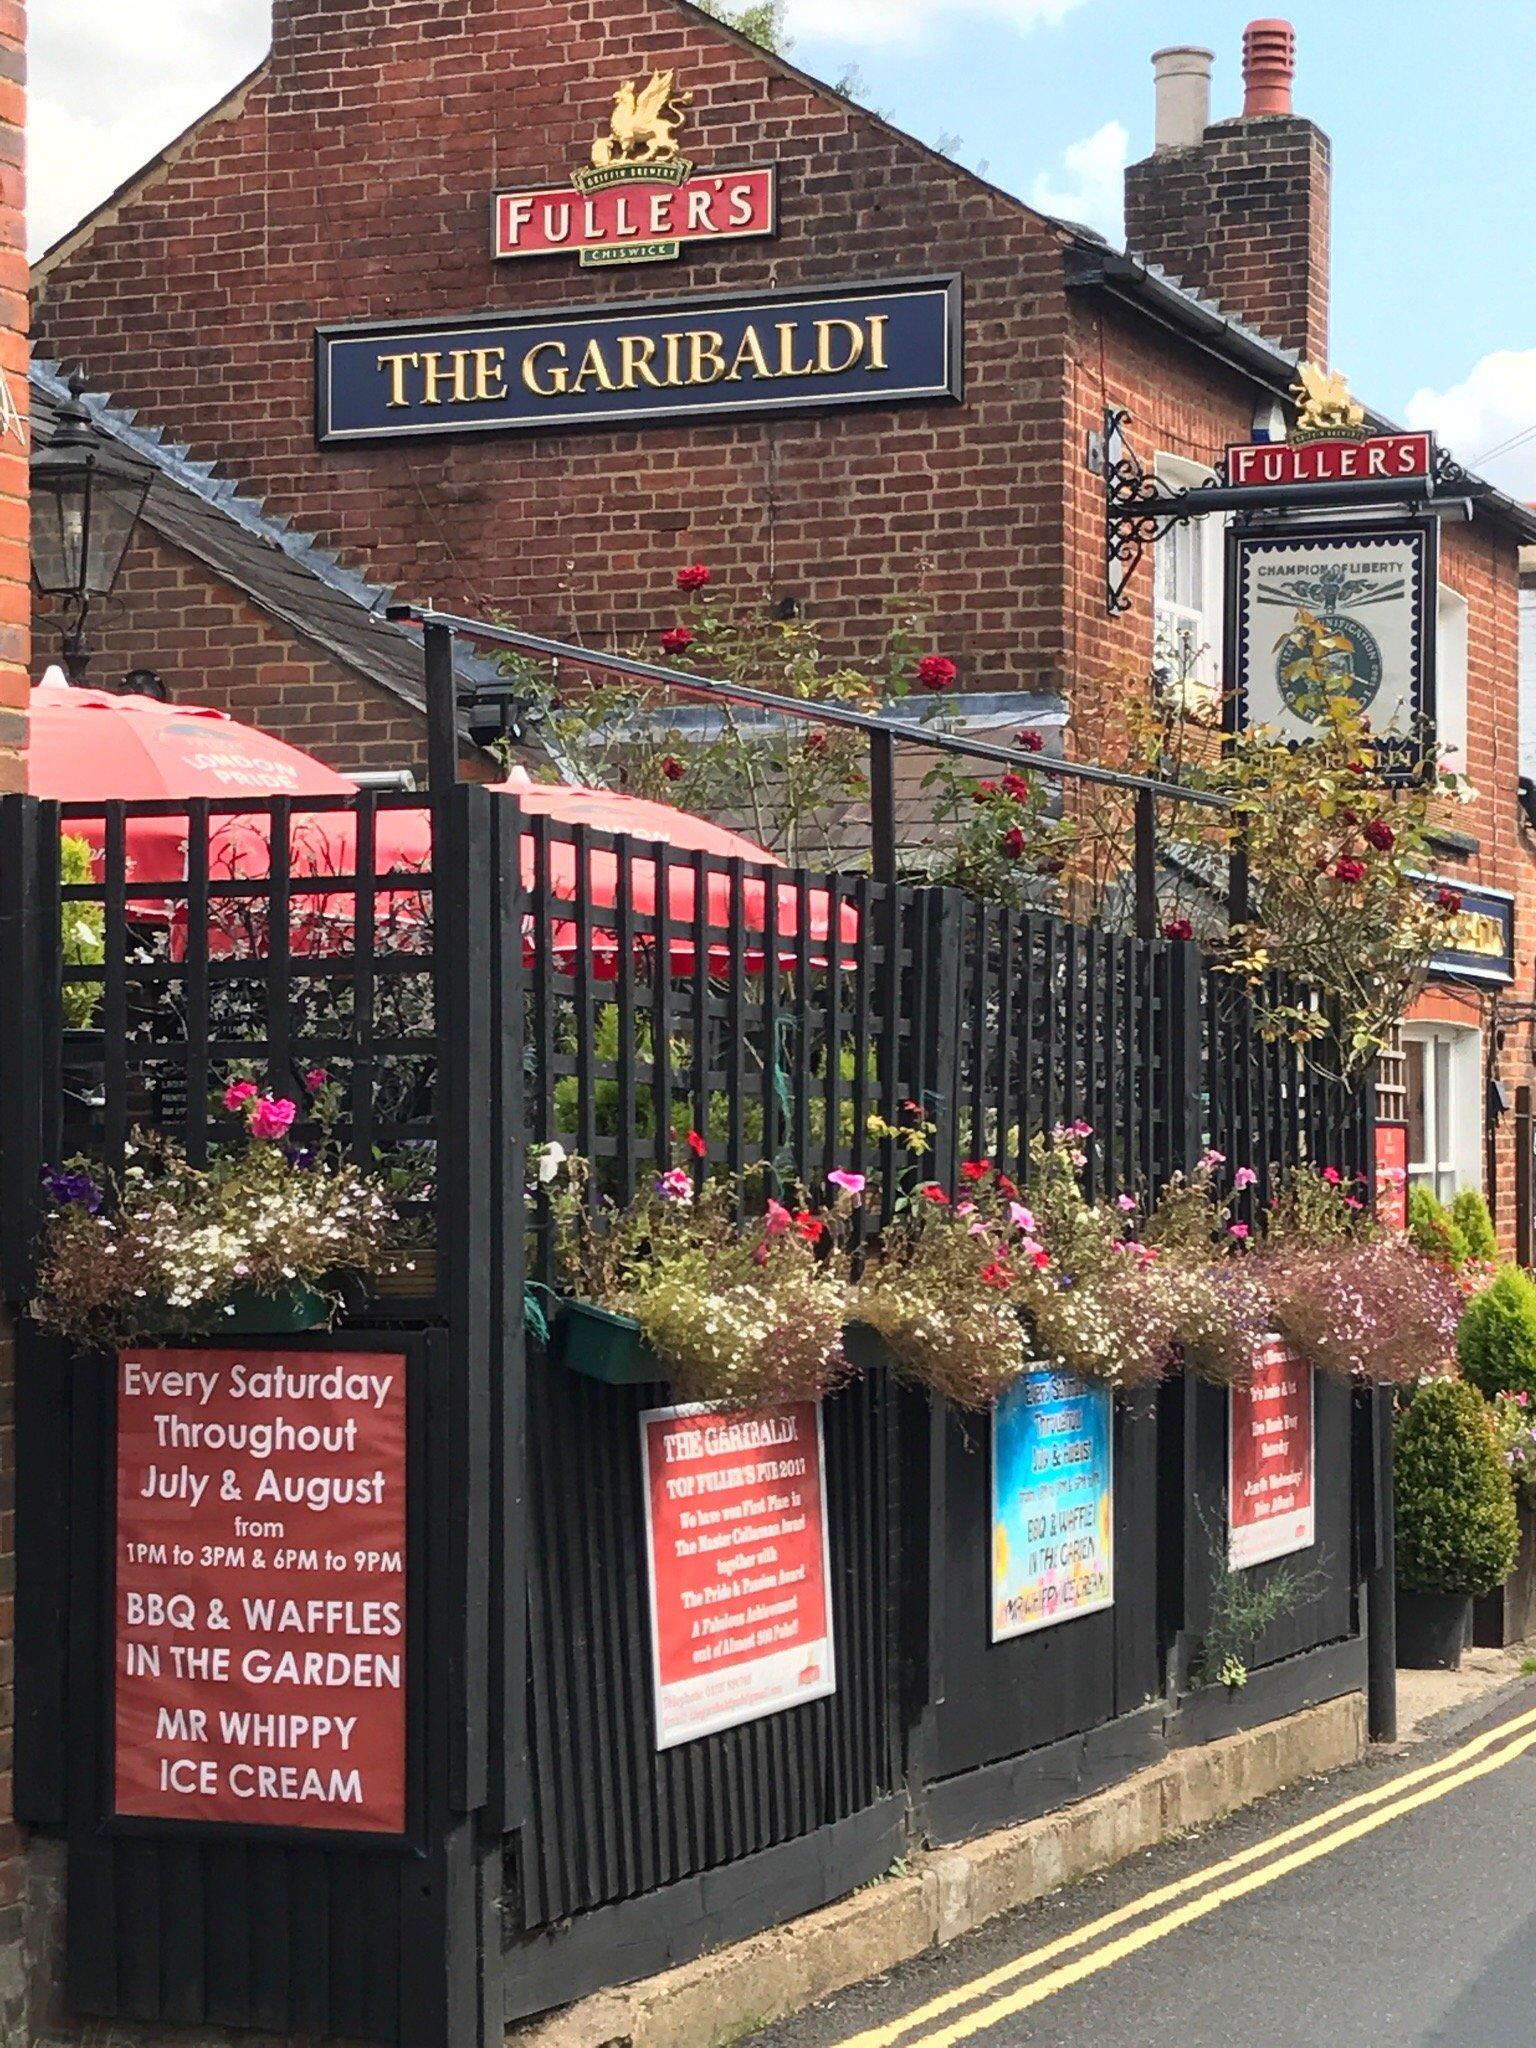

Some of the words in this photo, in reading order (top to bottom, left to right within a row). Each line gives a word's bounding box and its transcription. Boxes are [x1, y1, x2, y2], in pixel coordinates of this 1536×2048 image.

[508, 178, 752, 245] FULLER'S
[591, 245, 666, 261] CHISWICK
[377, 346, 508, 409] THE
[521, 313, 891, 397] GARIBALDI
[1238, 440, 1416, 482] FULLER'S
[1257, 564, 1329, 577] CHAMPION
[1350, 561, 1404, 575] LIBERTY
[1322, 617, 1378, 660] NIFICATION
[181, 753, 298, 778] LONDON
[212, 769, 299, 790] PRIDE
[124, 1362, 220, 1405] Every
[229, 1364, 394, 1409] Saturday
[153, 1414, 358, 1459] Throughout
[663, 1429, 704, 1463] THE
[141, 1464, 210, 1508] July
[219, 1468, 243, 1501] &
[255, 1468, 386, 1512] August
[666, 1474, 696, 1500] TOP
[695, 1463, 757, 1494] FULLER'S
[756, 1460, 780, 1484] PUB
[778, 1457, 806, 1479] 2017
[721, 1505, 743, 1520] won
[741, 1496, 767, 1518] First
[790, 1490, 802, 1507] in
[234, 1516, 285, 1539] from
[126, 1542, 168, 1565] 1PM
[172, 1543, 194, 1566] to
[199, 1545, 245, 1568] 3PM
[251, 1548, 266, 1570] &
[272, 1549, 318, 1571] 6PM
[324, 1551, 347, 1572] to
[353, 1550, 403, 1573] 9PM
[674, 1538, 698, 1558] The
[716, 1551, 757, 1578] together
[756, 1545, 779, 1565] with
[680, 1589, 704, 1610] The
[703, 1583, 732, 1605] Pride
[127, 1592, 196, 1632] BBQ
[206, 1598, 232, 1631] &
[242, 1597, 402, 1637] WAFFLES
[690, 1620, 701, 1639] A
[126, 1643, 161, 1677] IN
[169, 1646, 230, 1682] THE
[241, 1649, 400, 1688] GARDEN
[692, 1644, 712, 1664] out
[712, 1639, 723, 1659] of
[156, 1707, 209, 1743] MR
[219, 1710, 358, 1751] WHIPPY
[159, 1758, 218, 1795] ICE
[228, 1763, 364, 1804] CREAM
